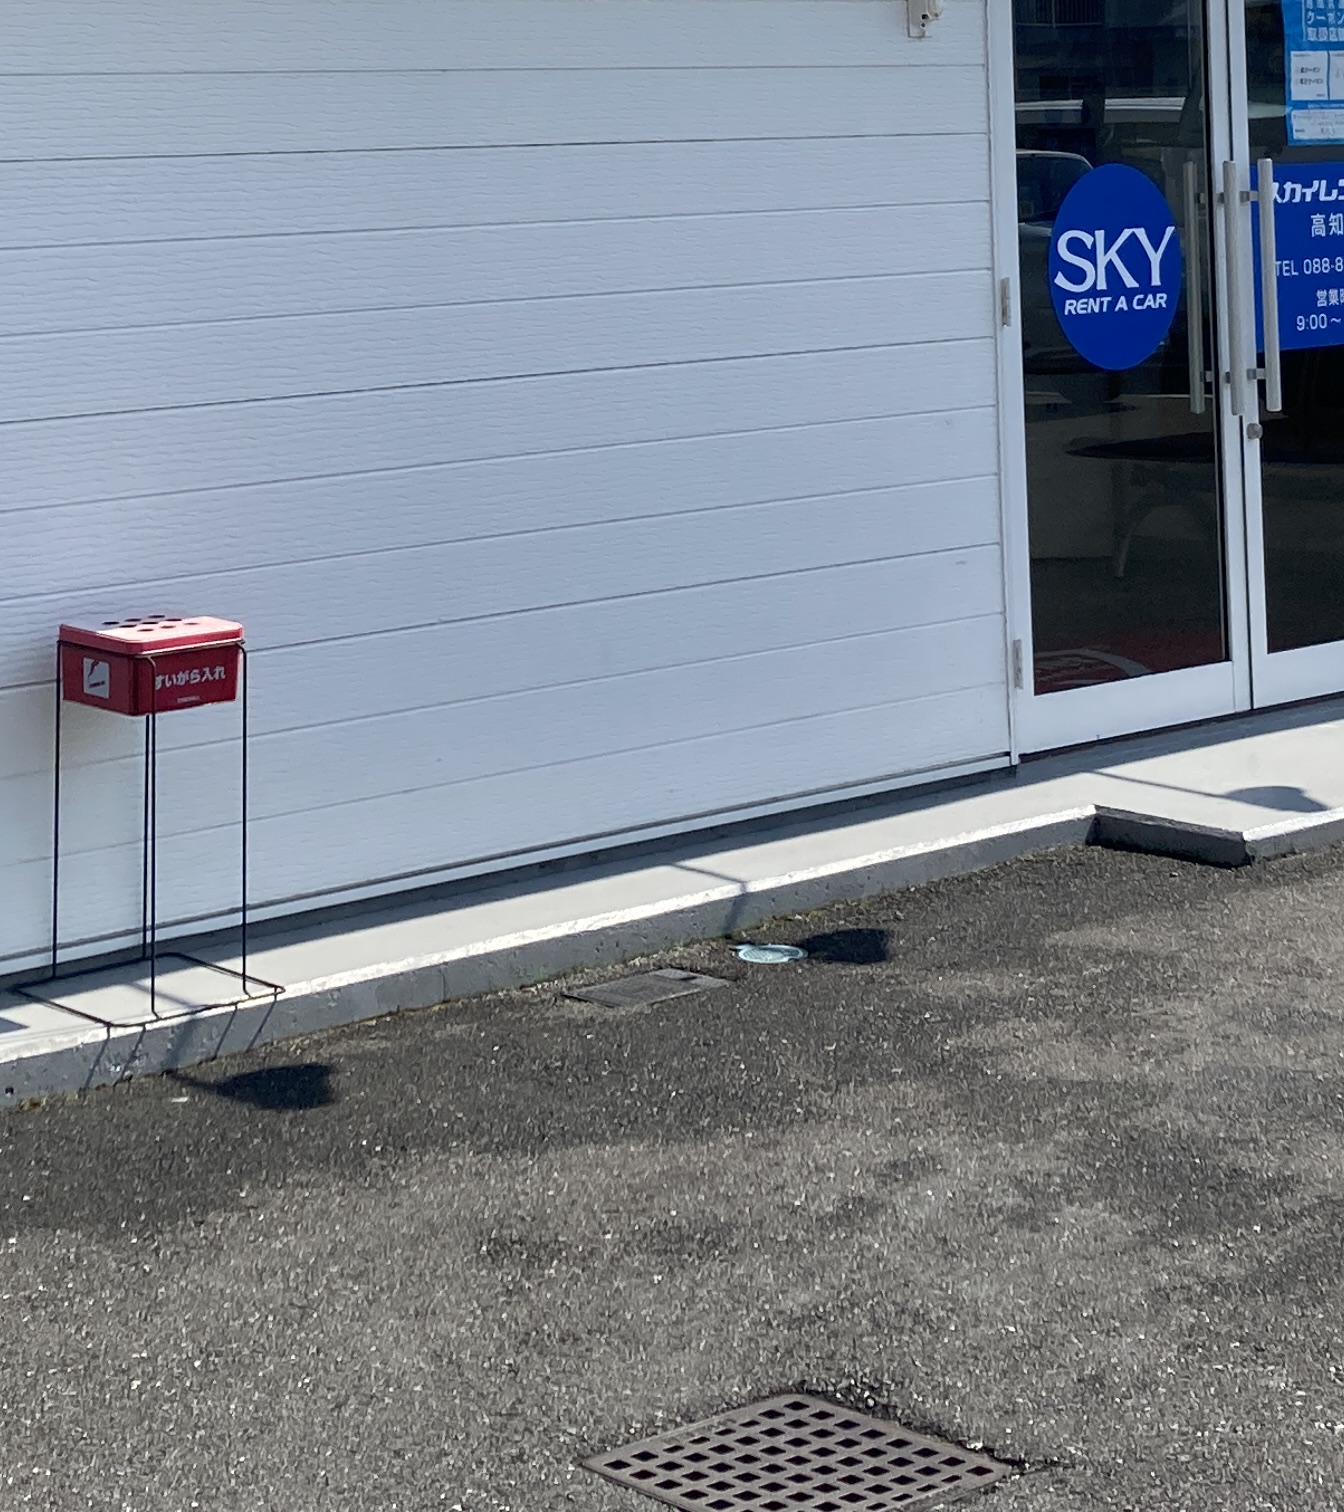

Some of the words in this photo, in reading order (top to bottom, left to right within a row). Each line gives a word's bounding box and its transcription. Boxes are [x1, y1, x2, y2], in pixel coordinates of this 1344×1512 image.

[1054, 225, 1175, 293] SKY
[1064, 297, 1112, 316] RENT
[1114, 295, 1129, 312] A
[1132, 293, 1168, 310] CAR
[155, 665, 226, 690] すいがら入れ
